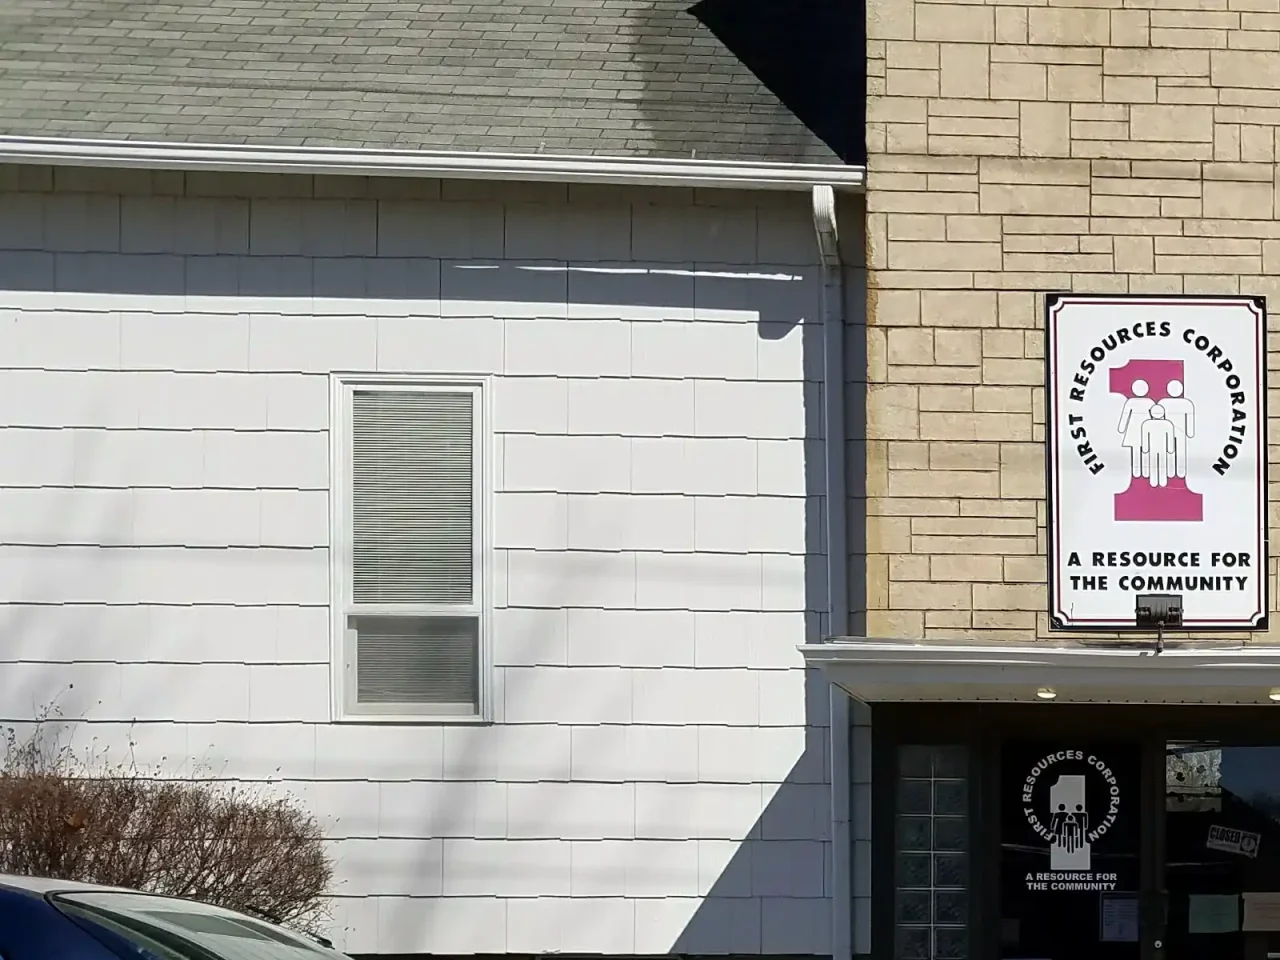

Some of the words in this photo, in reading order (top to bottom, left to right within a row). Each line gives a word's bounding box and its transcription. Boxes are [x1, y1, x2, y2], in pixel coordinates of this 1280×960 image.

[1068, 321, 1171, 403] RESOURCES
[1181, 327, 1247, 477] CORPORATION
[1068, 413, 1106, 476] FIRST
[1067, 551, 1082, 567] A
[1091, 551, 1201, 567] RESOURCE
[1210, 551, 1251, 568] FOR
[1069, 575, 1108, 591] THE
[1118, 575, 1249, 591] COMMUNITY
[1022, 750, 1084, 802] RESOURCES
[1087, 755, 1121, 842] CORPORATION
[1023, 807, 1055, 841] FIRST
[1209, 826, 1241, 844] CLOSED
[1025, 872, 1034, 881] A
[1036, 872, 1094, 881] RESOURCE
[1096, 872, 1118, 881] FOR
[1026, 882, 1048, 890] THE
[1050, 882, 1117, 891] COMMUNITY
